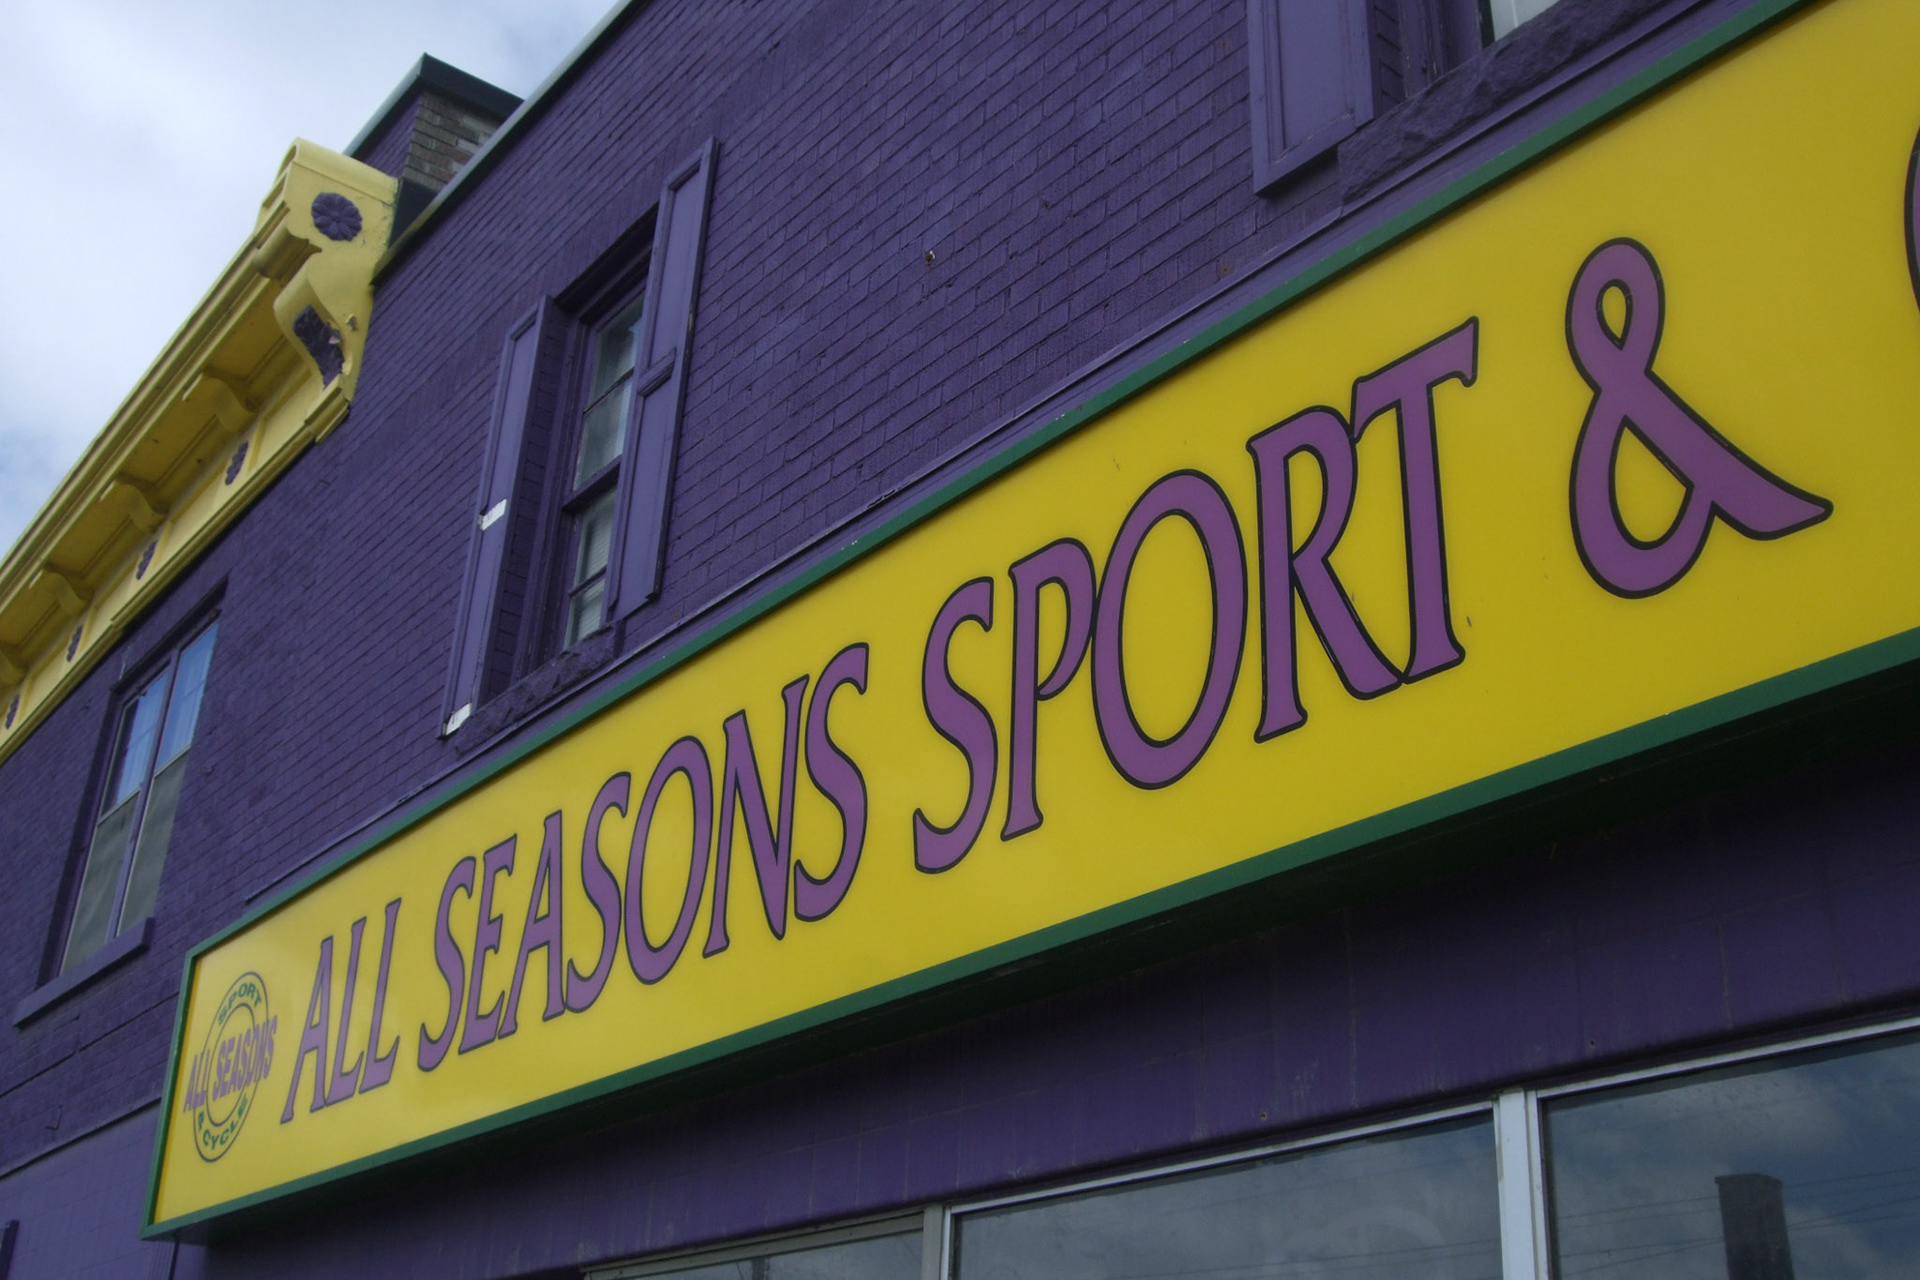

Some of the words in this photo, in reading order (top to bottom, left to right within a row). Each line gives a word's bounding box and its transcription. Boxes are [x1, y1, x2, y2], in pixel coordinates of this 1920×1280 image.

[280, 897, 402, 1125] ALL
[417, 641, 870, 1072] SEASONS
[912, 316, 1479, 874] SPORT
[1565, 236, 1834, 600] &
[217, 982, 262, 1027] SPORT
[183, 1047, 211, 1113] ALL
[212, 1014, 278, 1102] SEASONS
[202, 1093, 249, 1150] CYCLE
